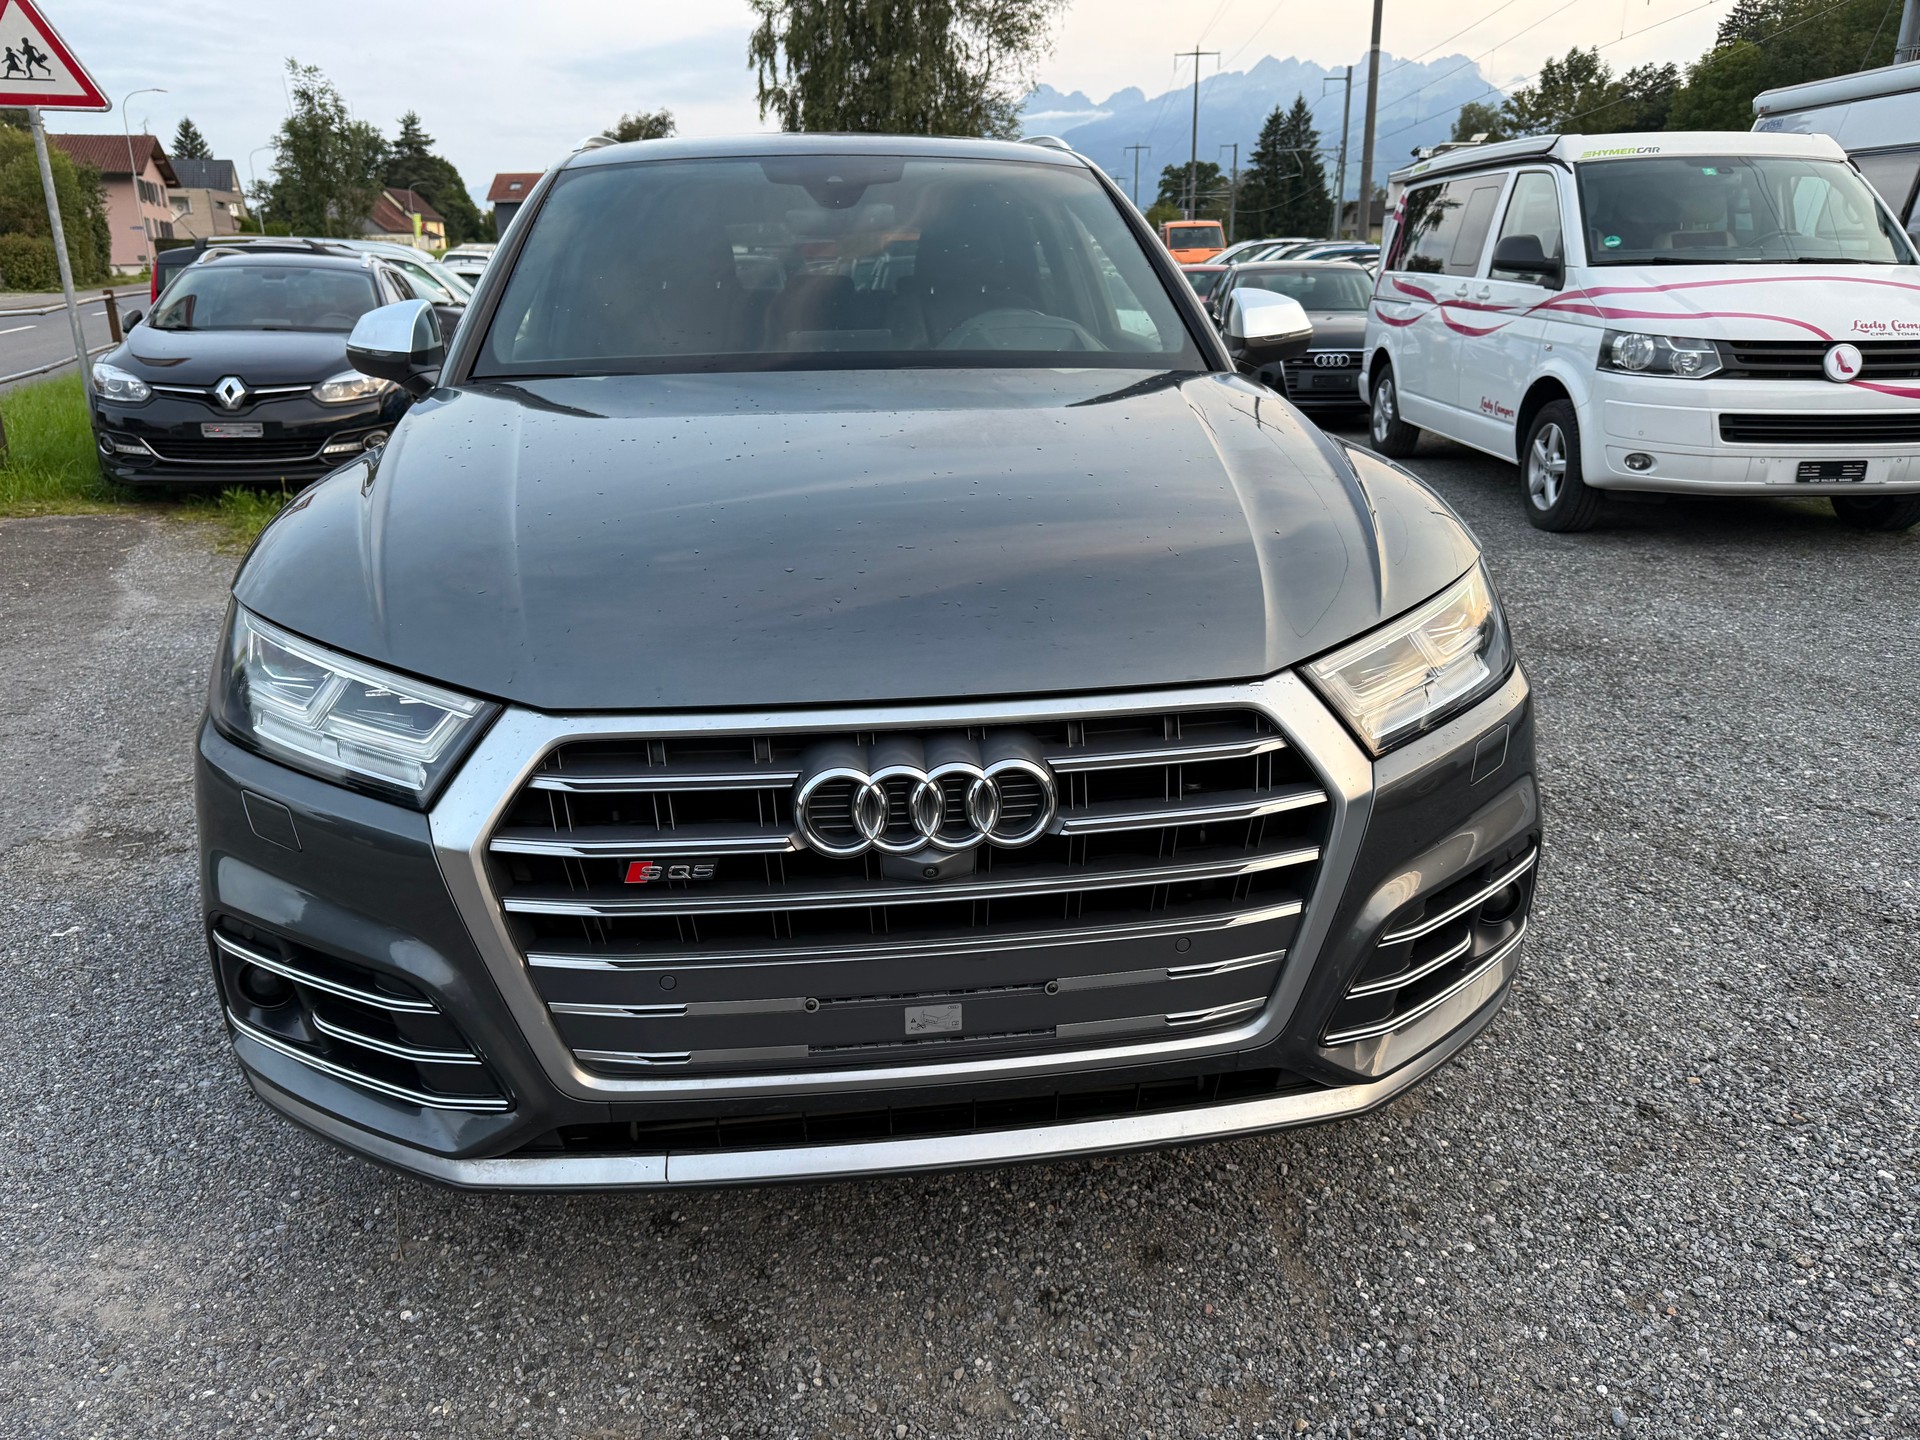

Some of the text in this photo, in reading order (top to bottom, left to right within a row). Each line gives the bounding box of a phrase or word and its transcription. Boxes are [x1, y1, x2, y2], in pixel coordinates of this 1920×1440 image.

[1591, 147, 1660, 157] HYMERCAR
[1850, 319, 1920, 333] Lady Cam
